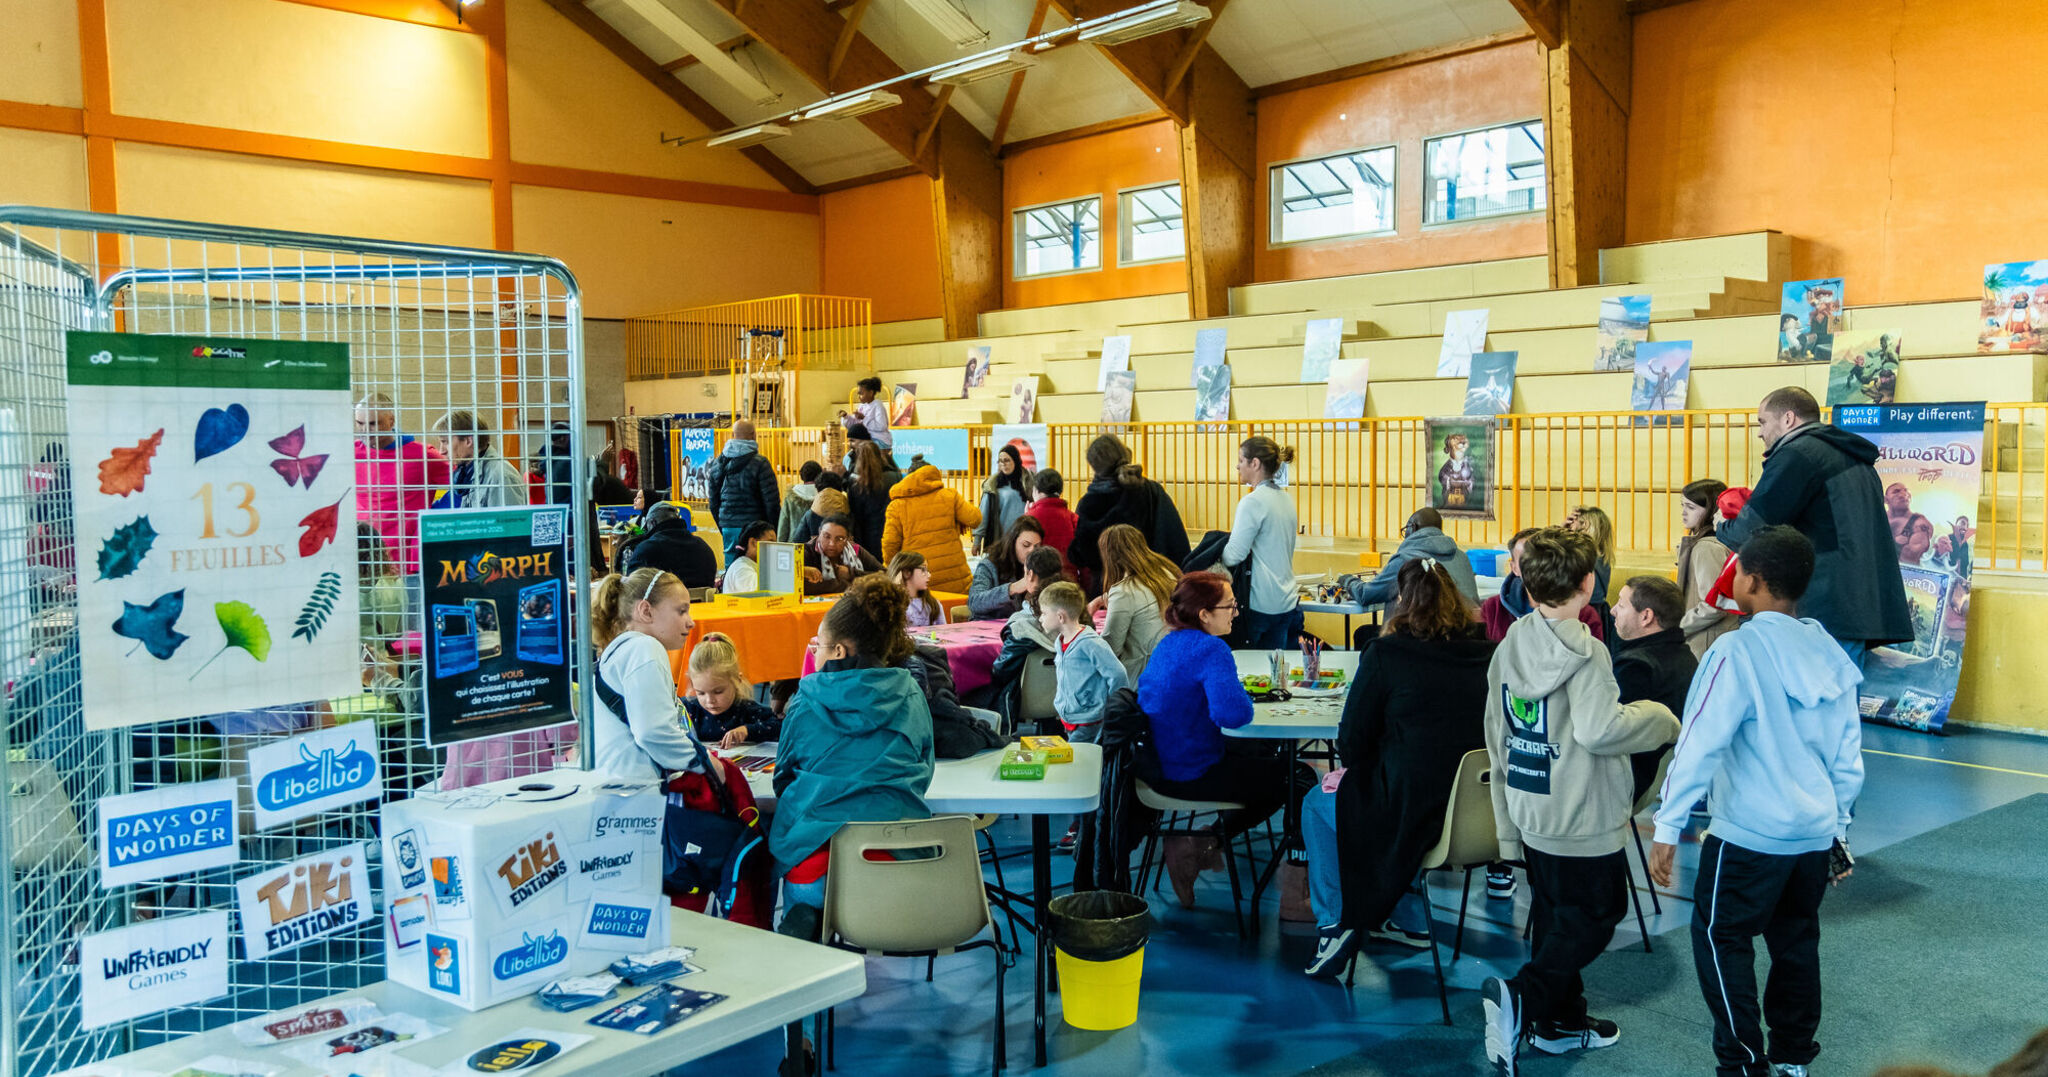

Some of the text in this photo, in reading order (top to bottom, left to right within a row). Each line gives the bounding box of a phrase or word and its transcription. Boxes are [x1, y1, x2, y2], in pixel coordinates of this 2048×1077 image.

[1842, 408, 1865, 416] DAYS
[1843, 416, 1878, 425] WONDER
[1890, 409, 1914, 424] Play
[1878, 442, 1975, 466] ALLWORLD
[189, 481, 260, 540] 13
[170, 544, 287, 572] FEUILLES
[480, 669, 524, 683] C'est VOUS
[455, 677, 550, 698] qui choisissez l'illustration
[471, 697, 482, 705] de
[482, 693, 511, 703] chaque
[511, 690, 532, 699] carte
[270, 749, 363, 804] Libellud
[115, 806, 225, 839] DAYS OF
[595, 816, 658, 837] grammes
[114, 827, 225, 862] WONDER
[1291, 849, 1310, 861] PU
[580, 850, 634, 874] UNFRIENDLY
[592, 868, 622, 881] Games
[595, 907, 647, 922] DAYS OF
[592, 920, 644, 935] WONDER
[103, 937, 212, 981] UNFRIENDLY
[502, 935, 561, 976] Libellud
[128, 967, 188, 991] Games
[276, 1012, 337, 1036] SPACE
